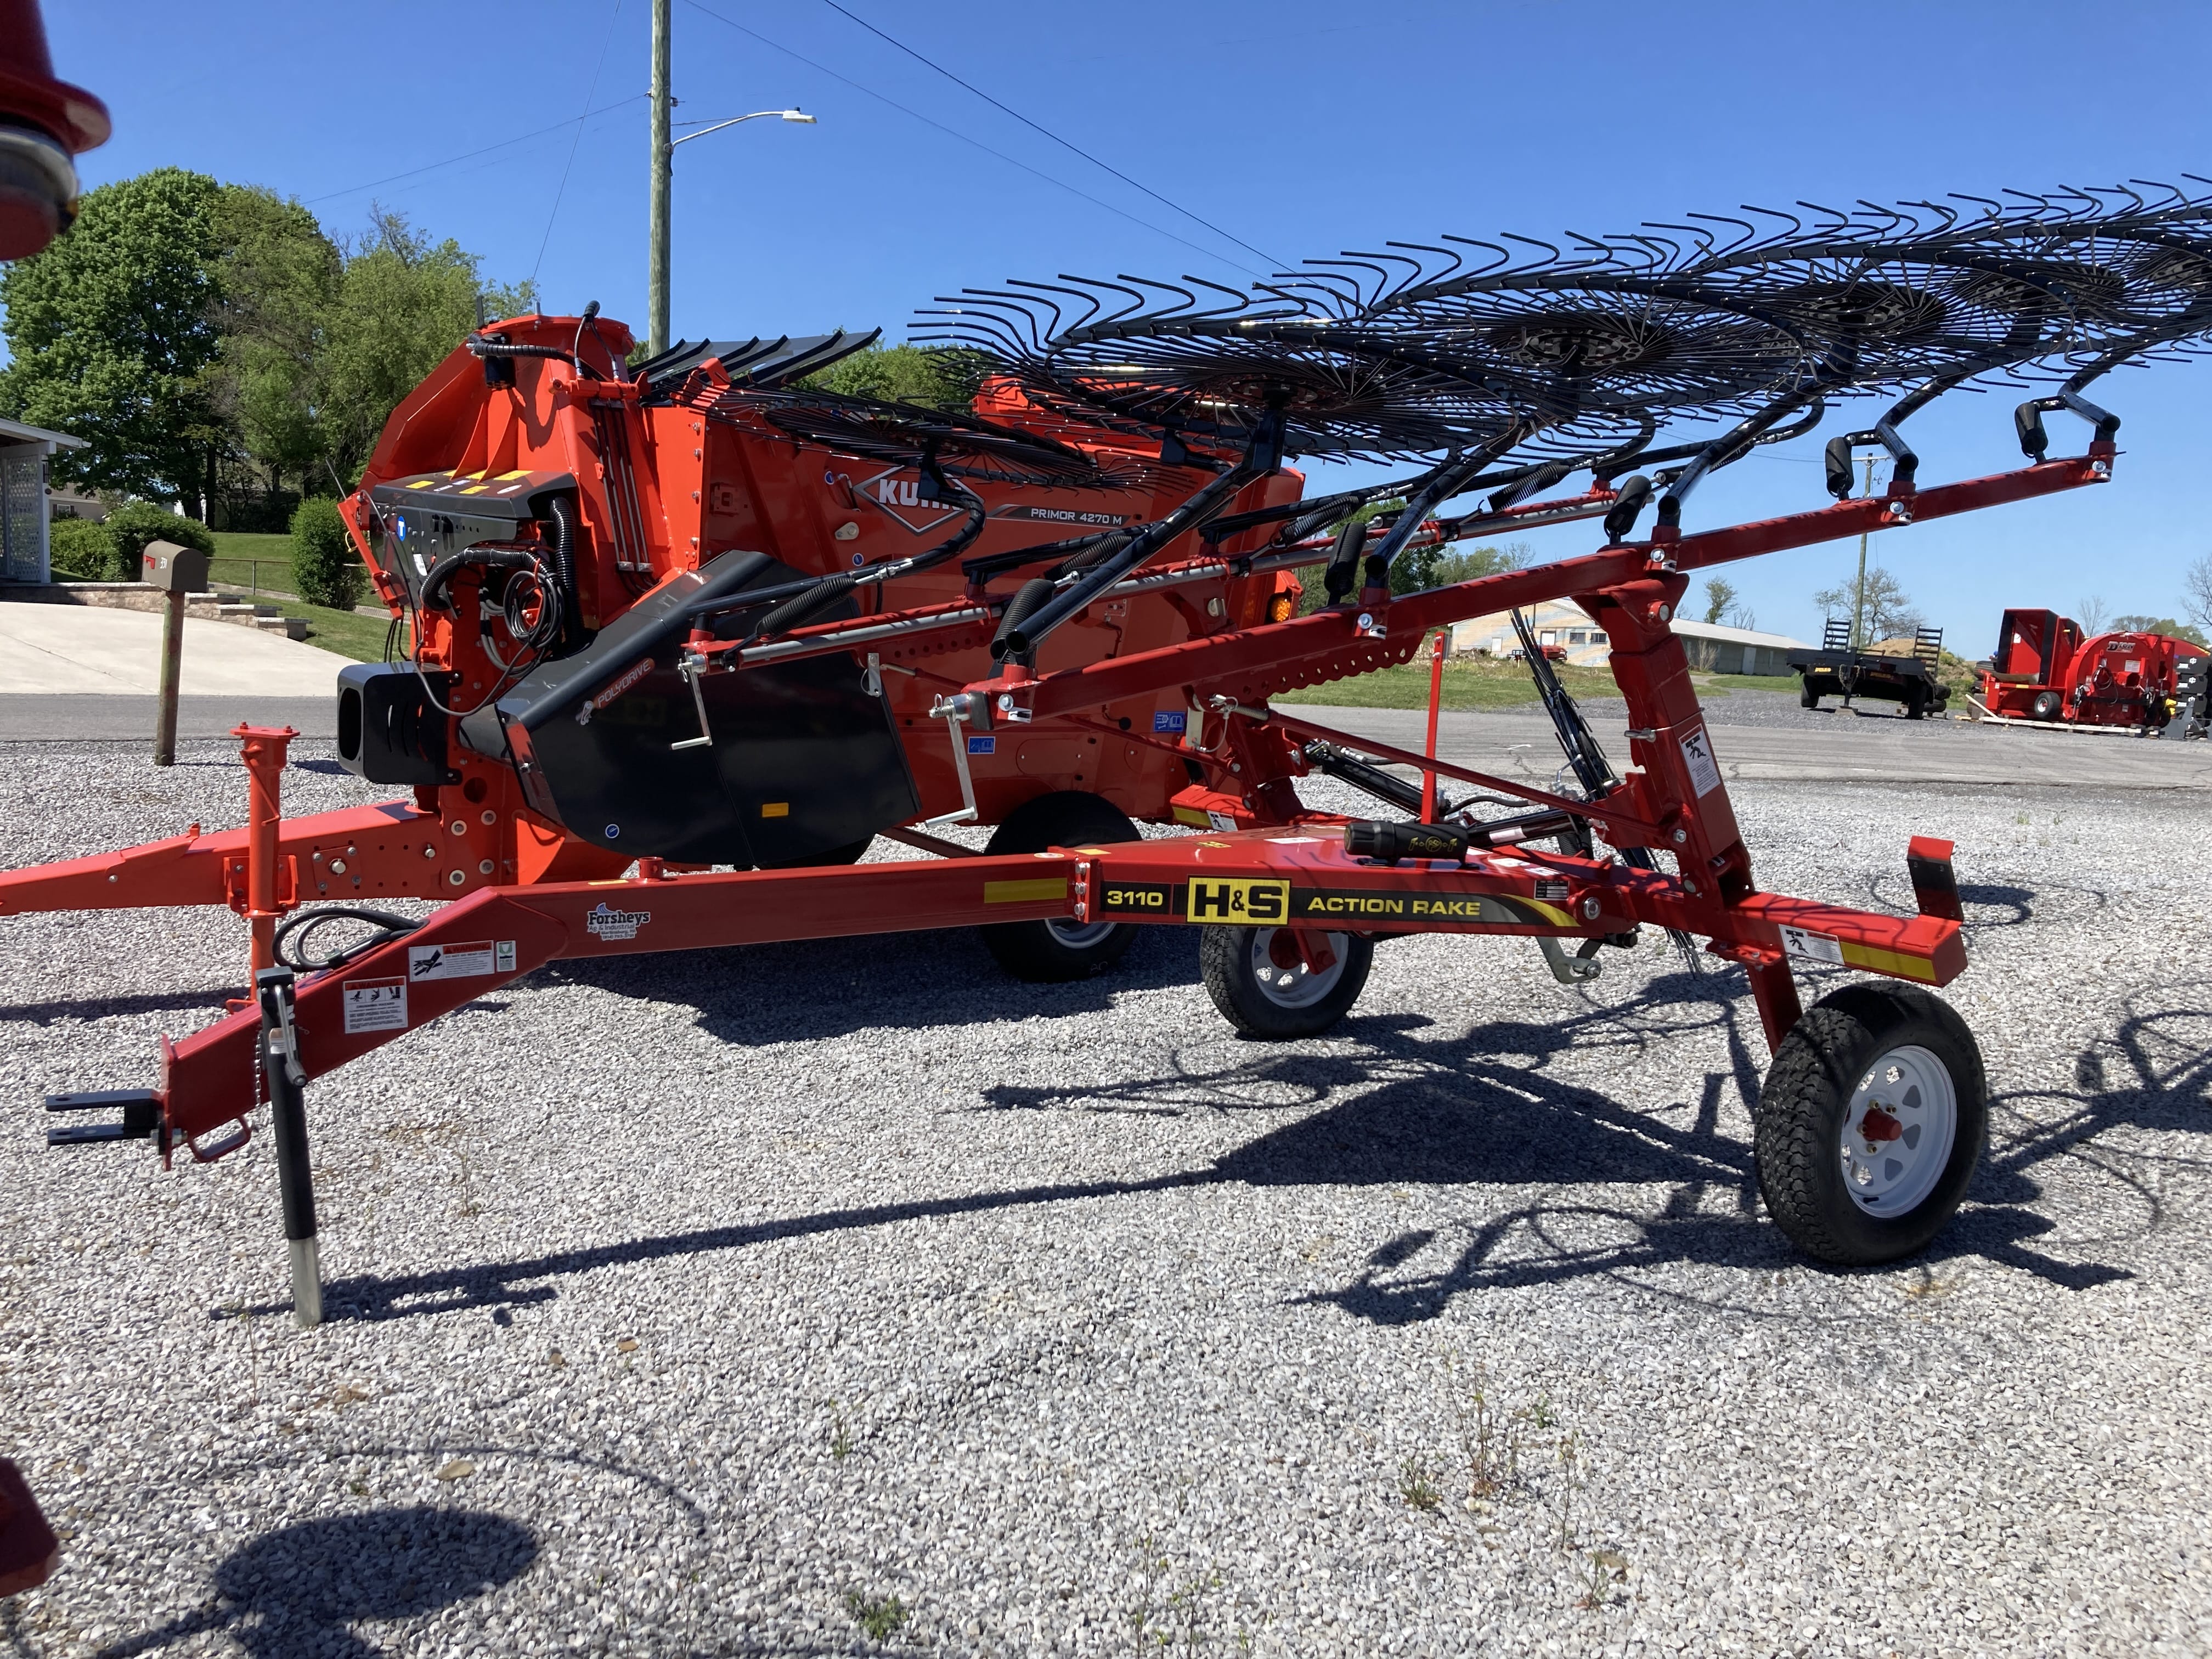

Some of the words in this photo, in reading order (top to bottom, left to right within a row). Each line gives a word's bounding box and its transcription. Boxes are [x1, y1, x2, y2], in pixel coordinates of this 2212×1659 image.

[1031, 508, 1075, 521] PRIMOR
[1080, 513, 1109, 524] 4270
[1113, 516, 1122, 525] M
[598, 659, 651, 708] POLYDRIVE
[1107, 890, 1163, 906] 3110
[1194, 884, 1283, 918] H&S
[1307, 897, 1403, 913] ACTION
[1413, 900, 1481, 915] RAKE
[589, 911, 650, 926] Forsheys
[453, 943, 490, 952] WARNING
[359, 979, 399, 988] WARNING
